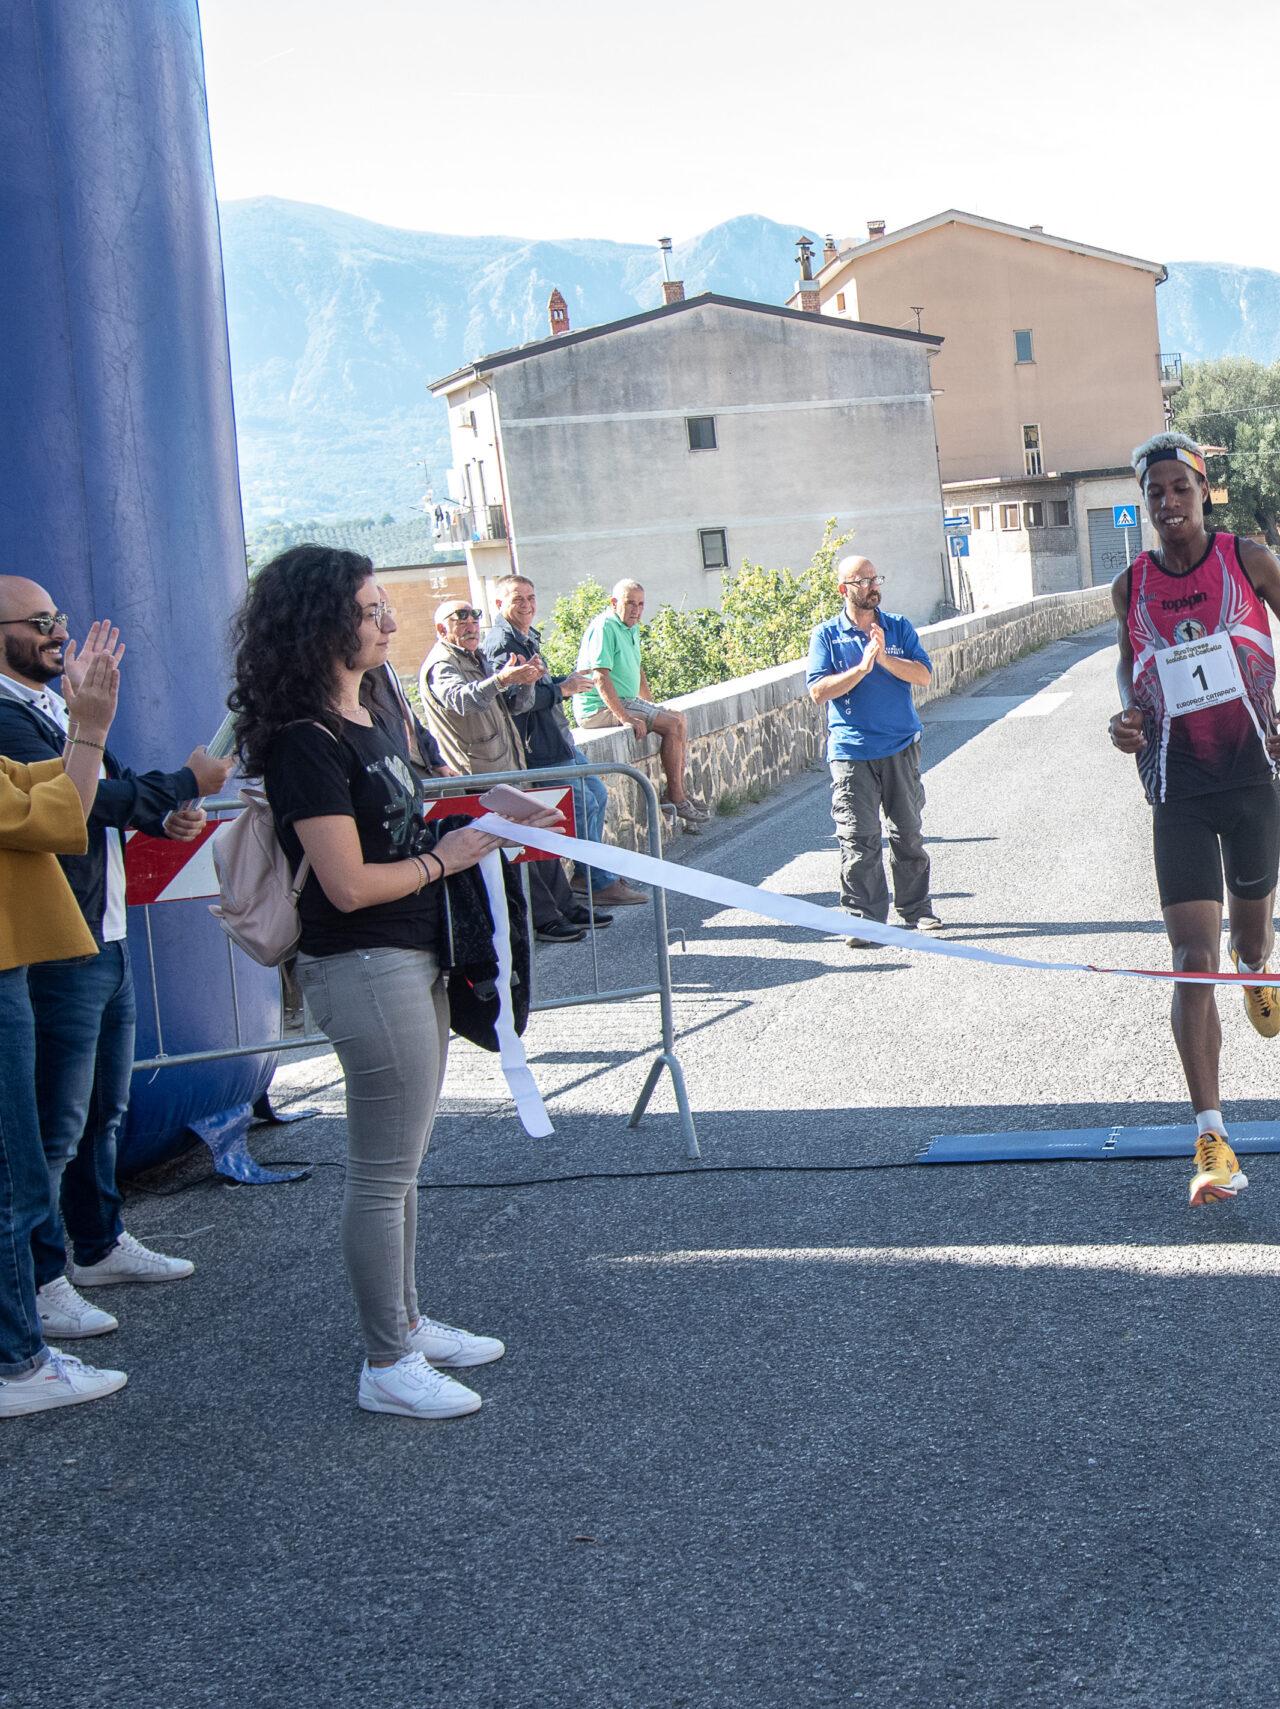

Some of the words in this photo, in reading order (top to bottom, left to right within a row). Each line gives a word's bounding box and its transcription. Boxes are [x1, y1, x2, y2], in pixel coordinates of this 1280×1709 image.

[953, 538, 964, 555] P
[1162, 592, 1207, 612] topspin
[1192, 664, 1208, 691] 1
